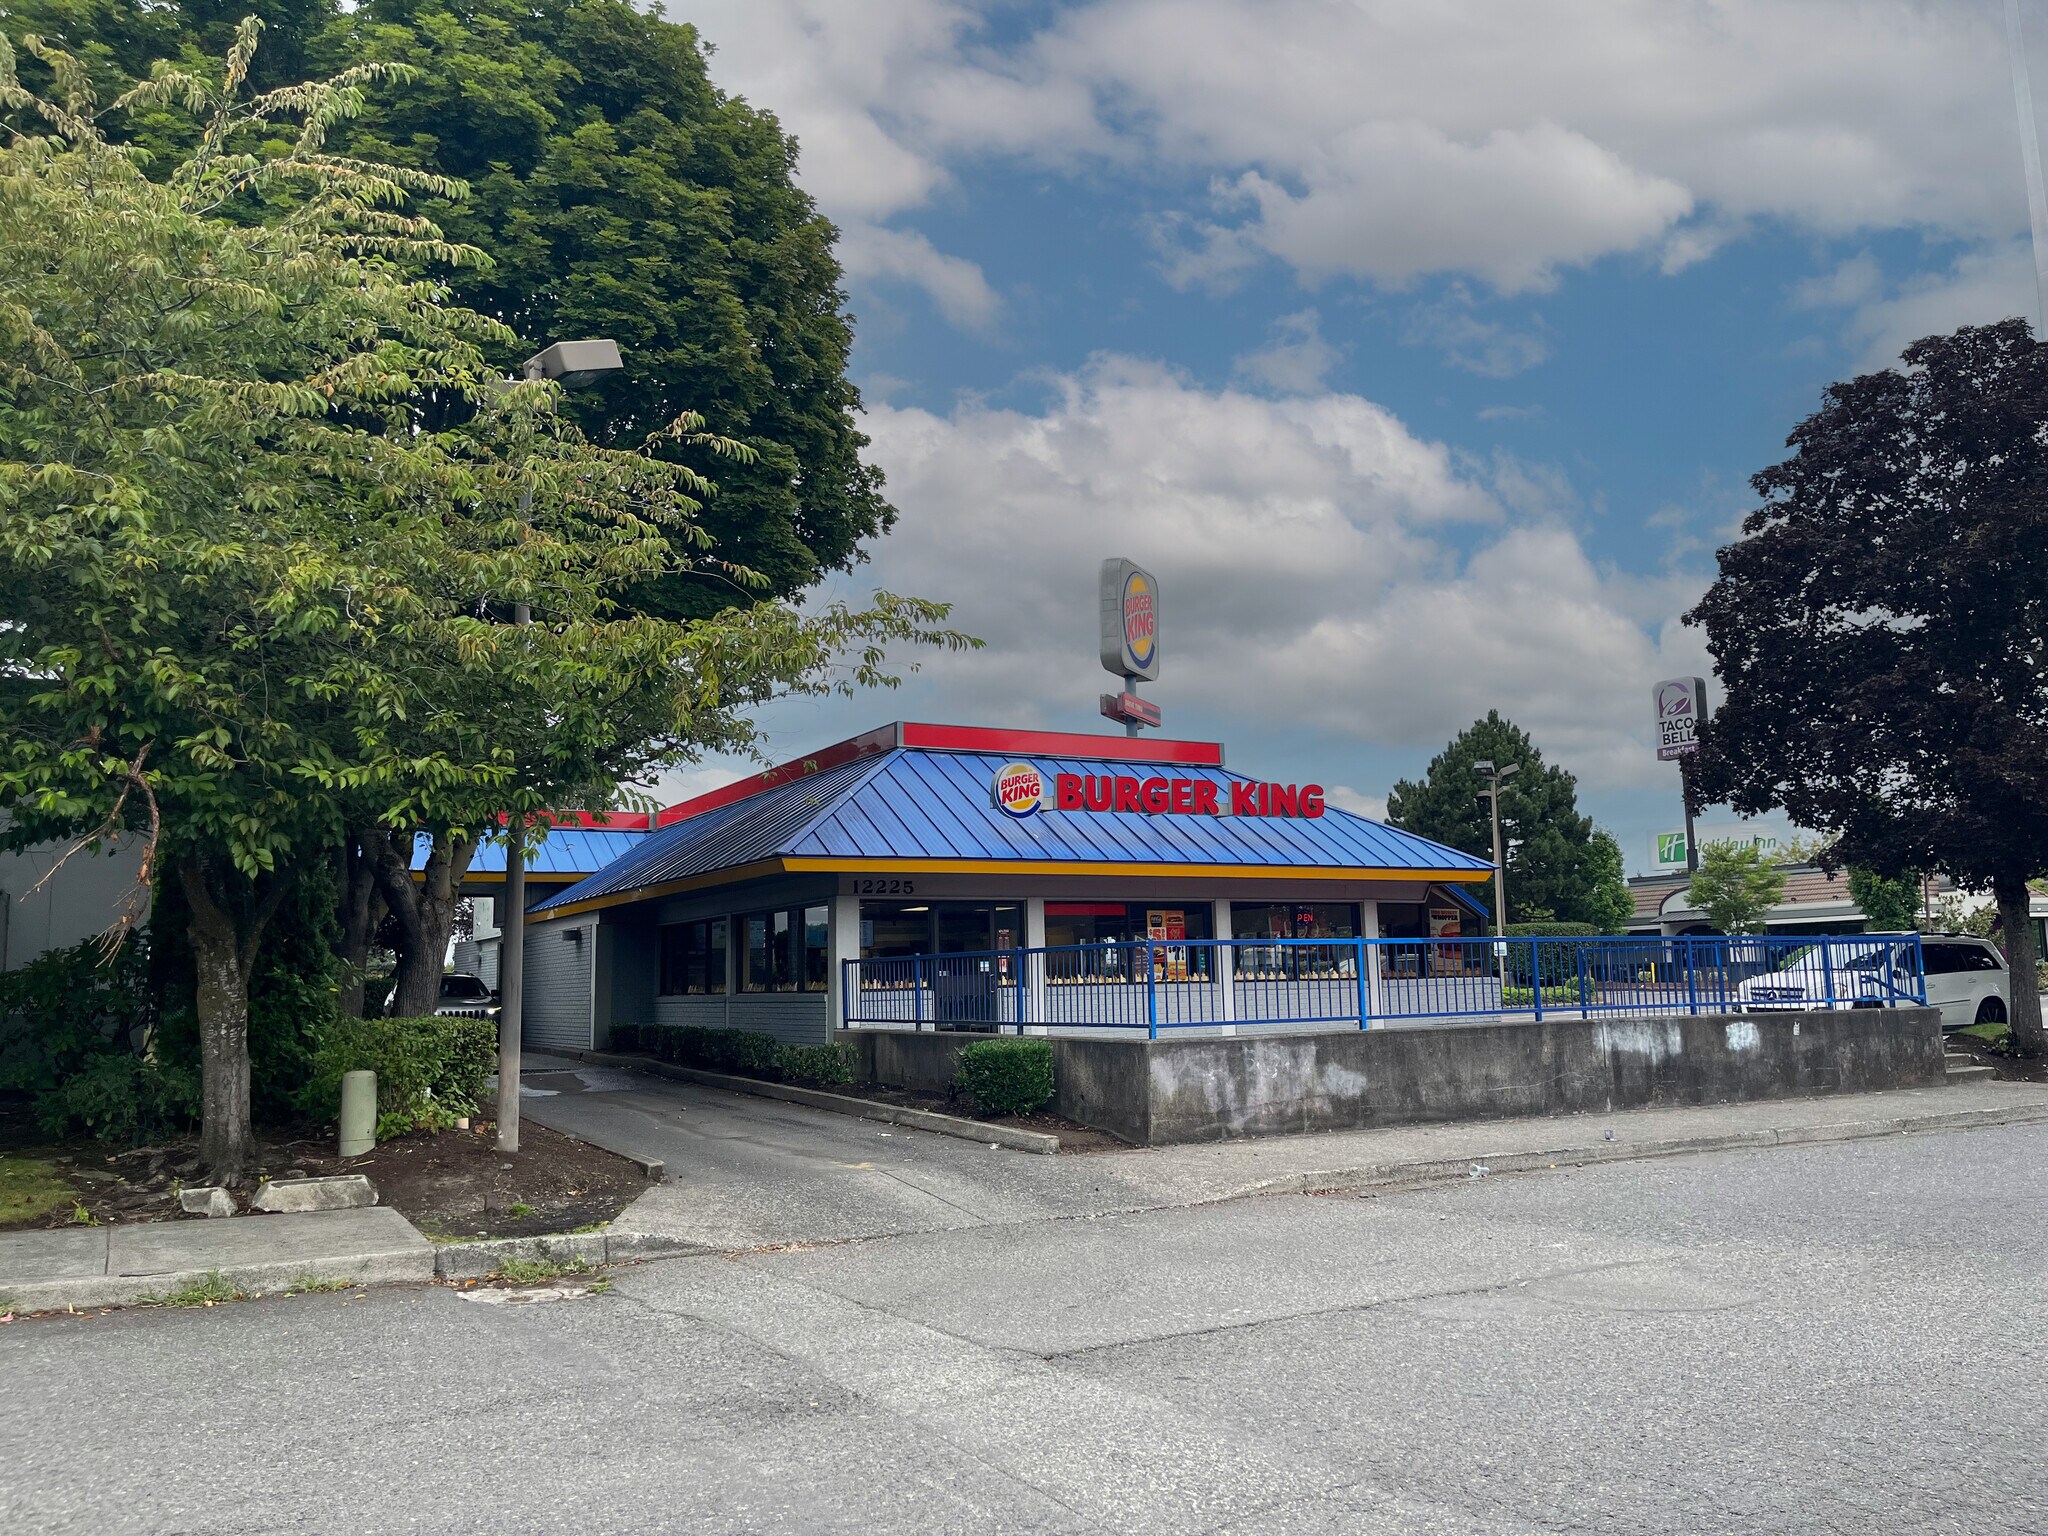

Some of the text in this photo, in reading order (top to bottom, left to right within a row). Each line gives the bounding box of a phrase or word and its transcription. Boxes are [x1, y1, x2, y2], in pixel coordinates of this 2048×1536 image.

[1126, 594, 1153, 617] BURGER
[1127, 611, 1154, 643] KING
[1659, 717, 1694, 733] TACO
[1662, 730, 1695, 746] BELL
[1001, 773, 1039, 790] BURGER
[1002, 783, 1040, 804] KING
[1056, 773, 1325, 818] BURGER KING
[853, 879, 914, 894] 12225
